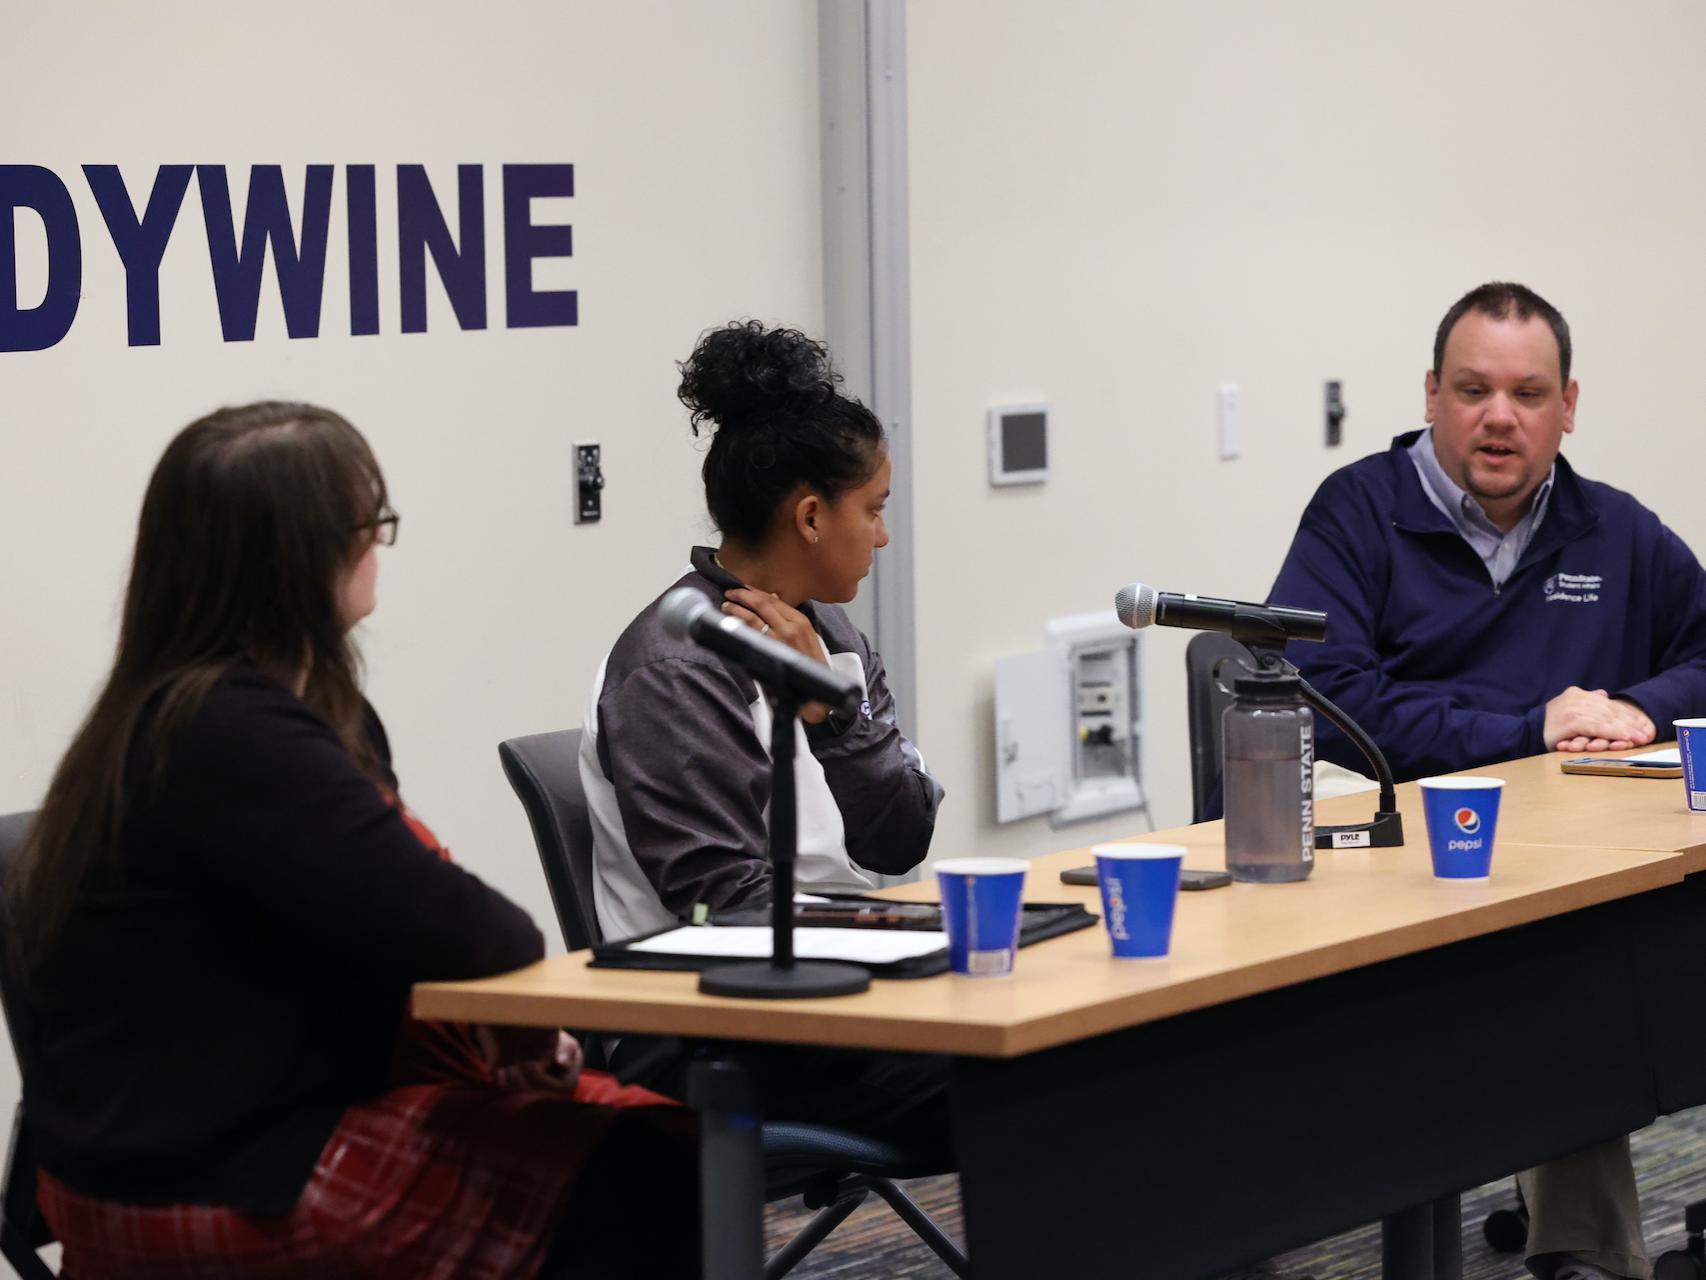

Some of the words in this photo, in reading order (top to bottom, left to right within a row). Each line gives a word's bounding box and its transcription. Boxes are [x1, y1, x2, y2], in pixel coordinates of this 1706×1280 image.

[0, 164, 578, 352] DYWINE
[1300, 726, 1312, 793] STATE
[1301, 800, 1313, 862] PENN
[1448, 838, 1482, 851] pepsi
